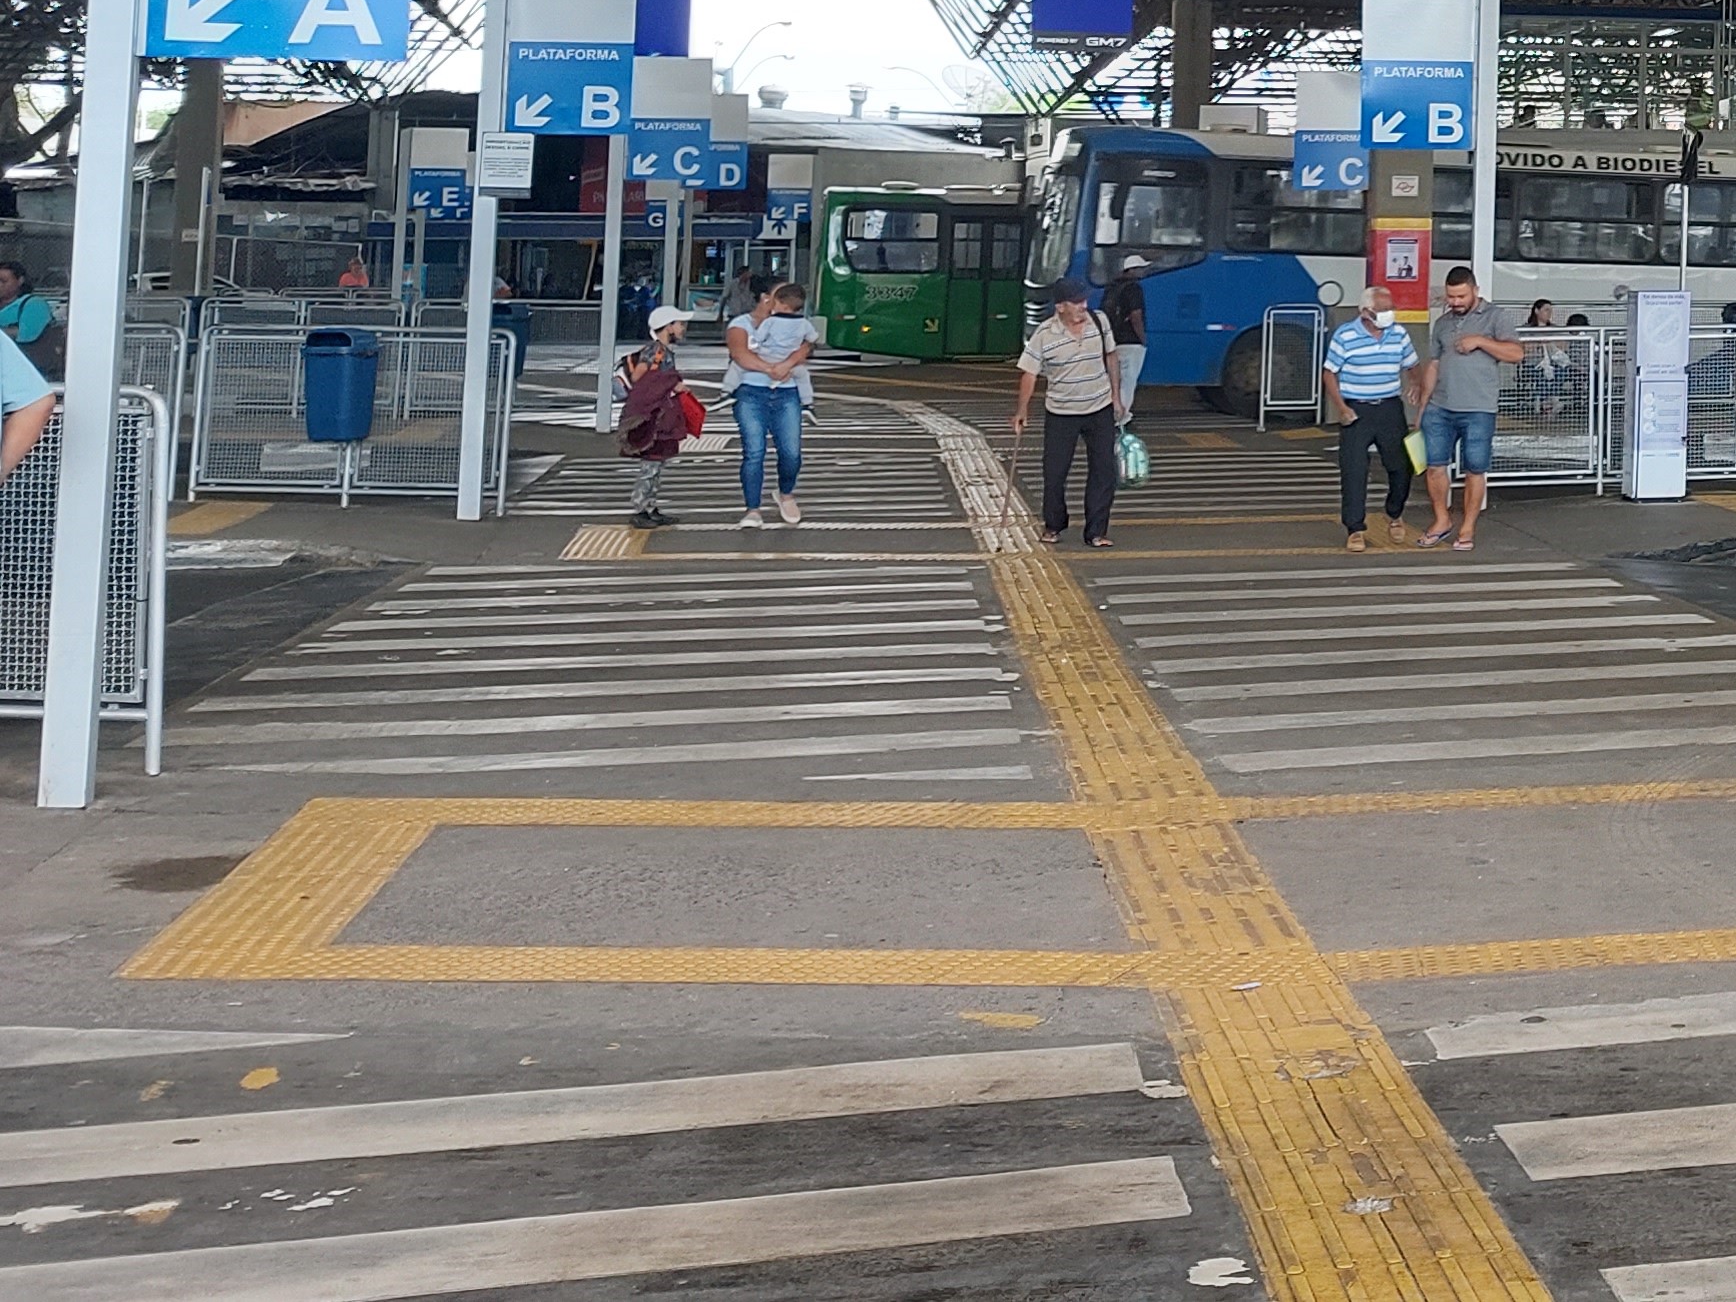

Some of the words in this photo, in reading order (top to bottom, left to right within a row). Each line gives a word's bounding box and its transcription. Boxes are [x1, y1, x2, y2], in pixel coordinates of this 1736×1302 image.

[1085, 36, 1127, 48] GM7
[518, 48, 620, 61] PLATAFORMA
[1373, 66, 1465, 79] PLATAFORMA
[580, 85, 621, 128] B
[634, 121, 702, 132] PLATAFORMA
[1427, 102, 1464, 144] B
[1301, 133, 1361, 143] PLATAFORMA
[673, 146, 701, 176] C
[1572, 155, 1588, 170] A
[719, 163, 741, 187] D
[1338, 157, 1364, 186] C
[442, 186, 460, 207] E
[793, 202, 809, 220] F
[647, 212, 664, 228] G
[864, 285, 919, 301] 3347
